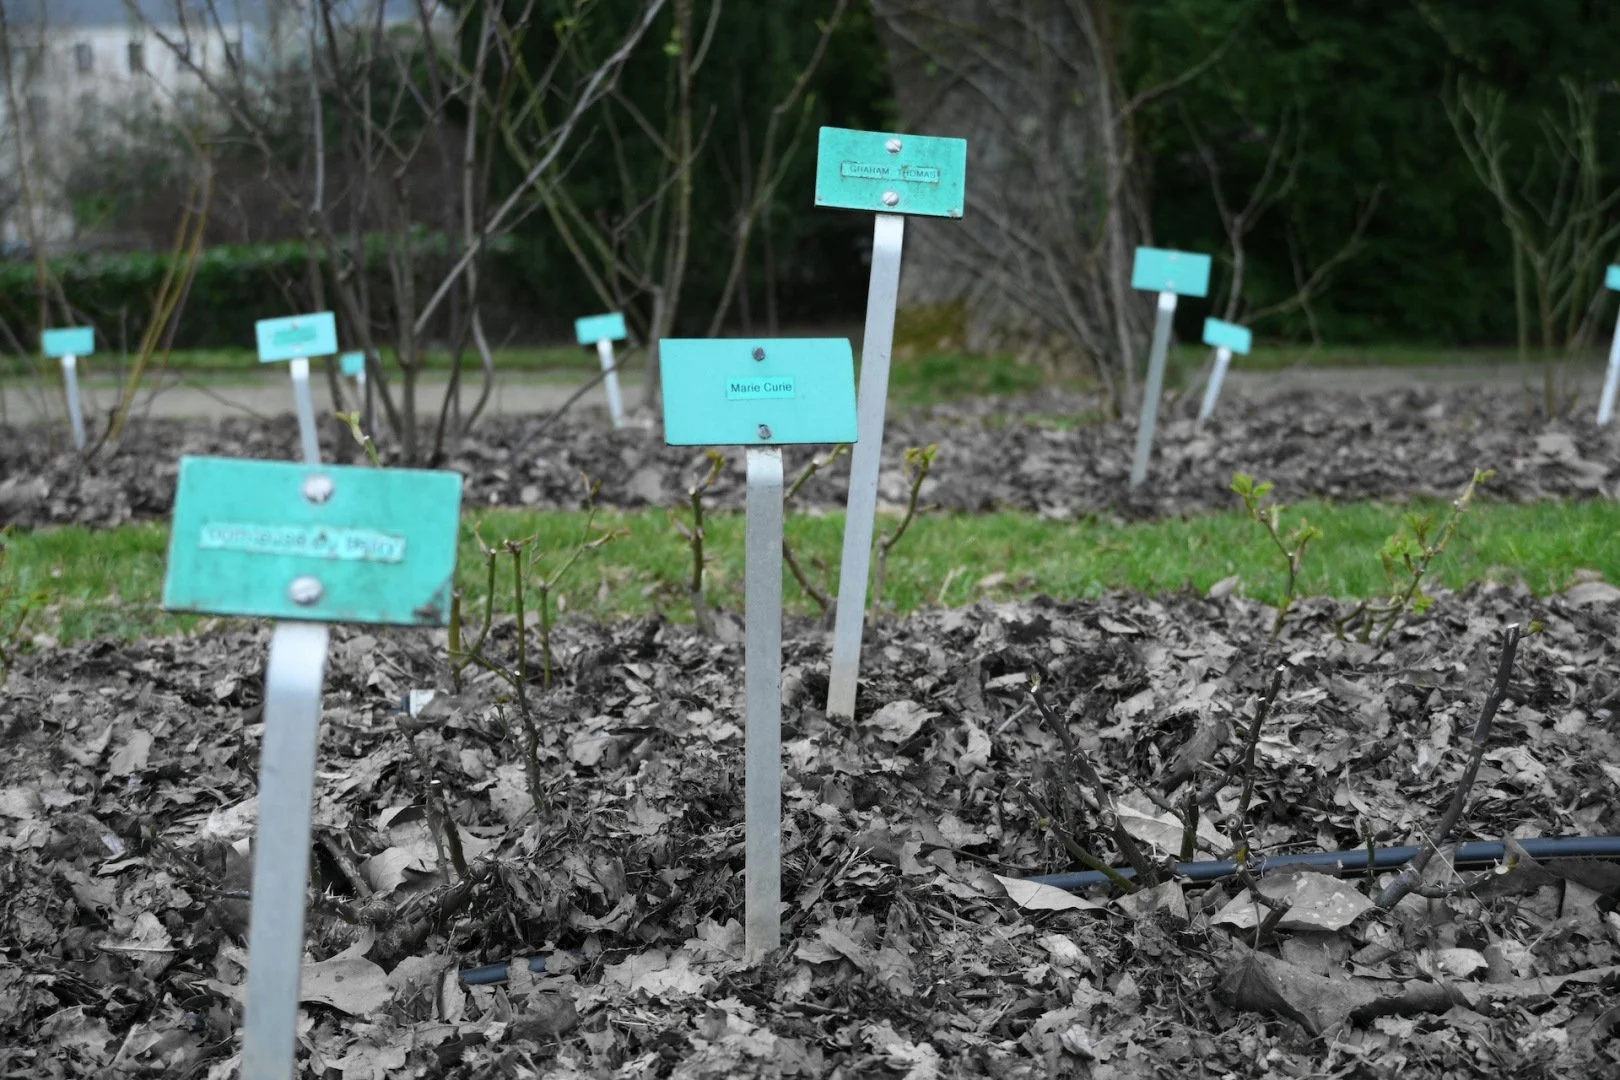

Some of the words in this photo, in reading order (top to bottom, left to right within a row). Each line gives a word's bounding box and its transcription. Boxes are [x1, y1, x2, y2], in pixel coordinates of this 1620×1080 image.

[849, 164, 890, 175] GRAHAM
[897, 168, 937, 179] THOMAS
[730, 383, 761, 393] Marie
[763, 381, 793, 392] Curie
